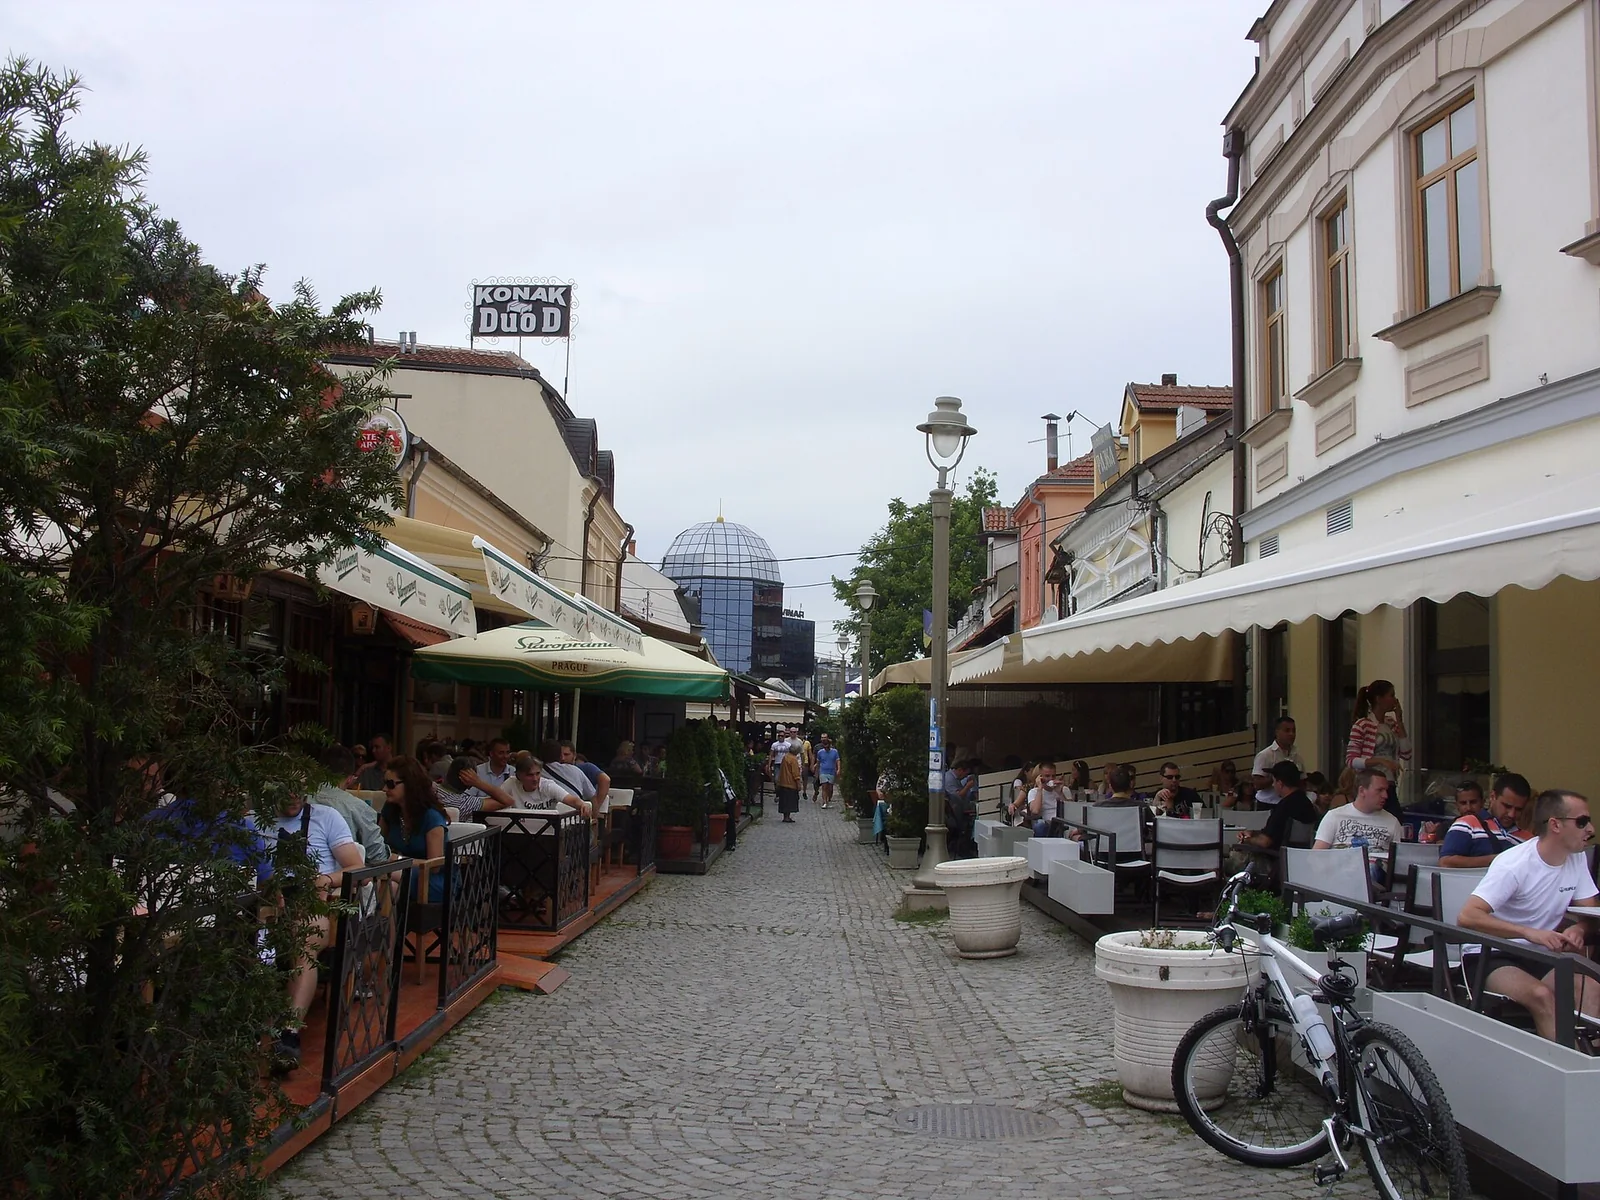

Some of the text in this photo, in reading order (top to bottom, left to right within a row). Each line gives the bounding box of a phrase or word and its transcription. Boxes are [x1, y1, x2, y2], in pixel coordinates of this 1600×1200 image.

[475, 286, 567, 307] KONAK
[478, 307, 537, 333] Duo
[551, 661, 588, 672] PRAGUE
